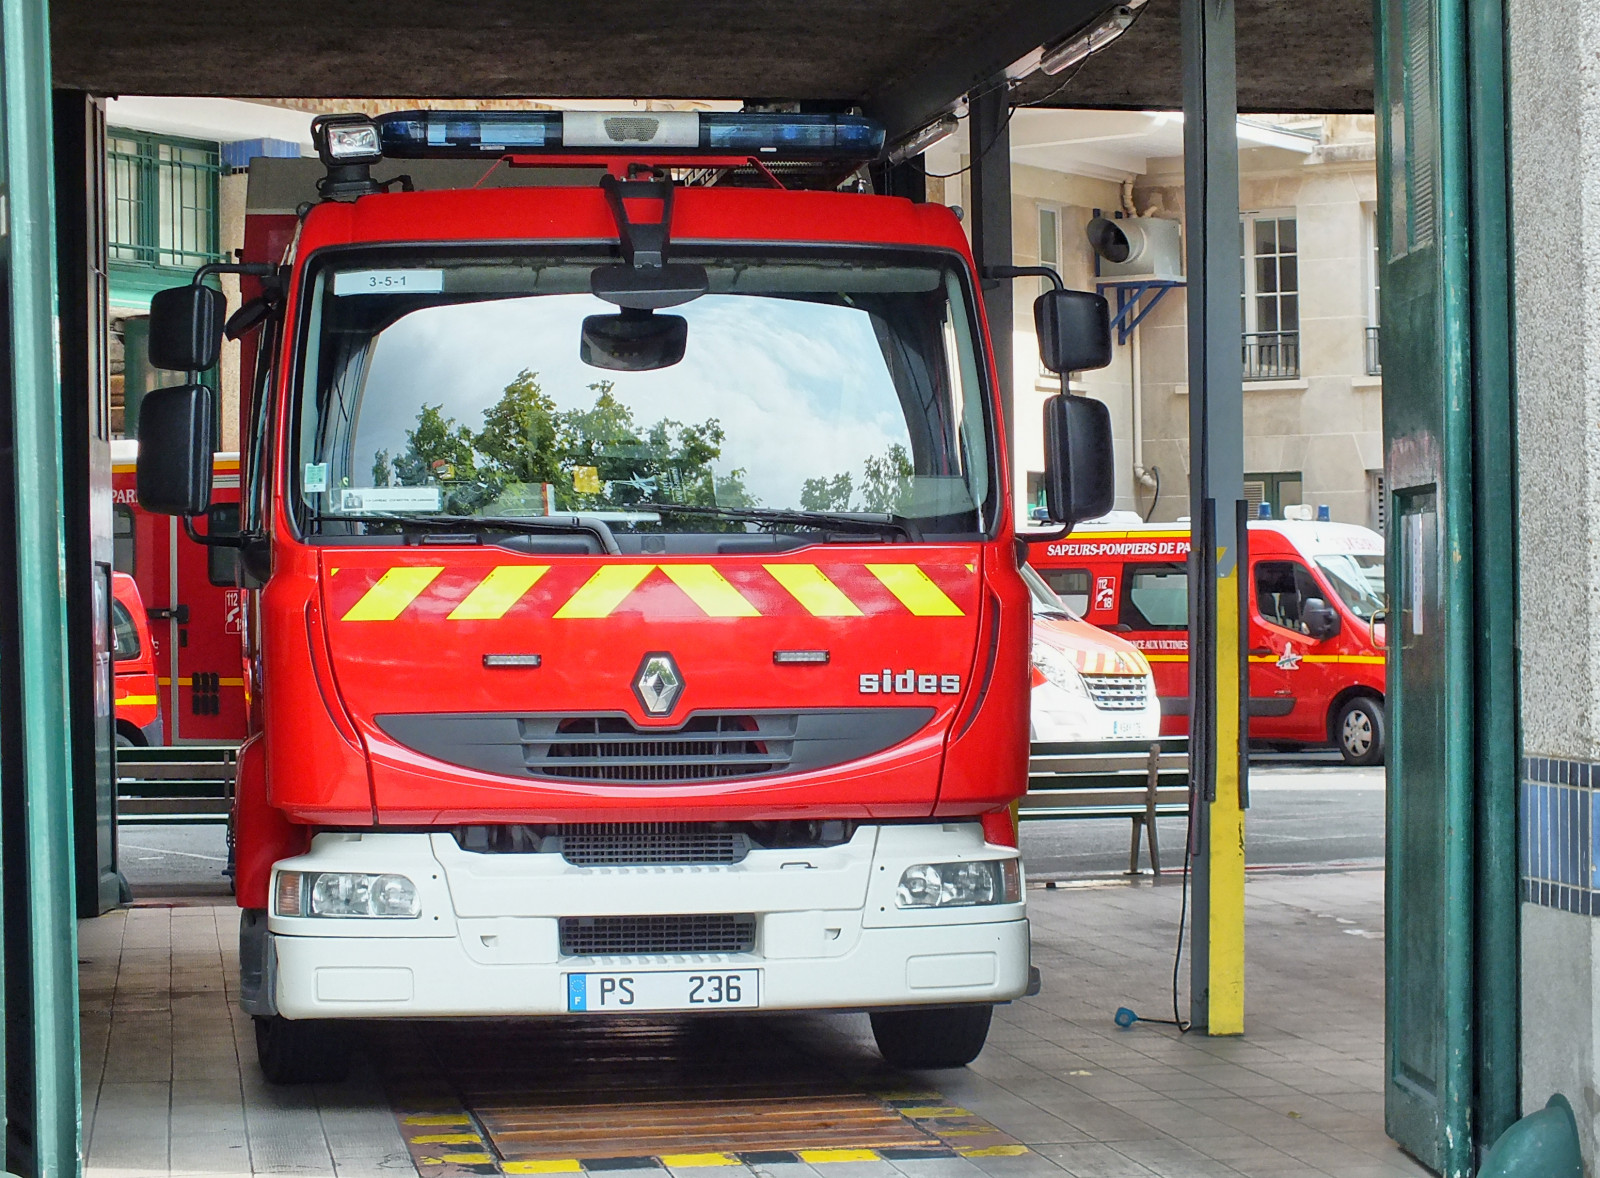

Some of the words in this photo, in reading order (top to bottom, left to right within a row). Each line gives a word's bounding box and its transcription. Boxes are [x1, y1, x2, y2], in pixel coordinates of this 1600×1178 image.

[369, 276, 407, 287] 3-5-1
[1047, 542, 1157, 556] SAPEURS-POMPIERS
[1158, 542, 1175, 554] DE
[1098, 578, 1108, 589] 112
[226, 592, 238, 607] 112
[1103, 597, 1112, 608] 18
[1158, 640, 1188, 650] VICTIMES
[859, 668, 961, 694] sides
[600, 977, 635, 1006] PS
[688, 975, 742, 1004] 236
[574, 996, 582, 1005] F
